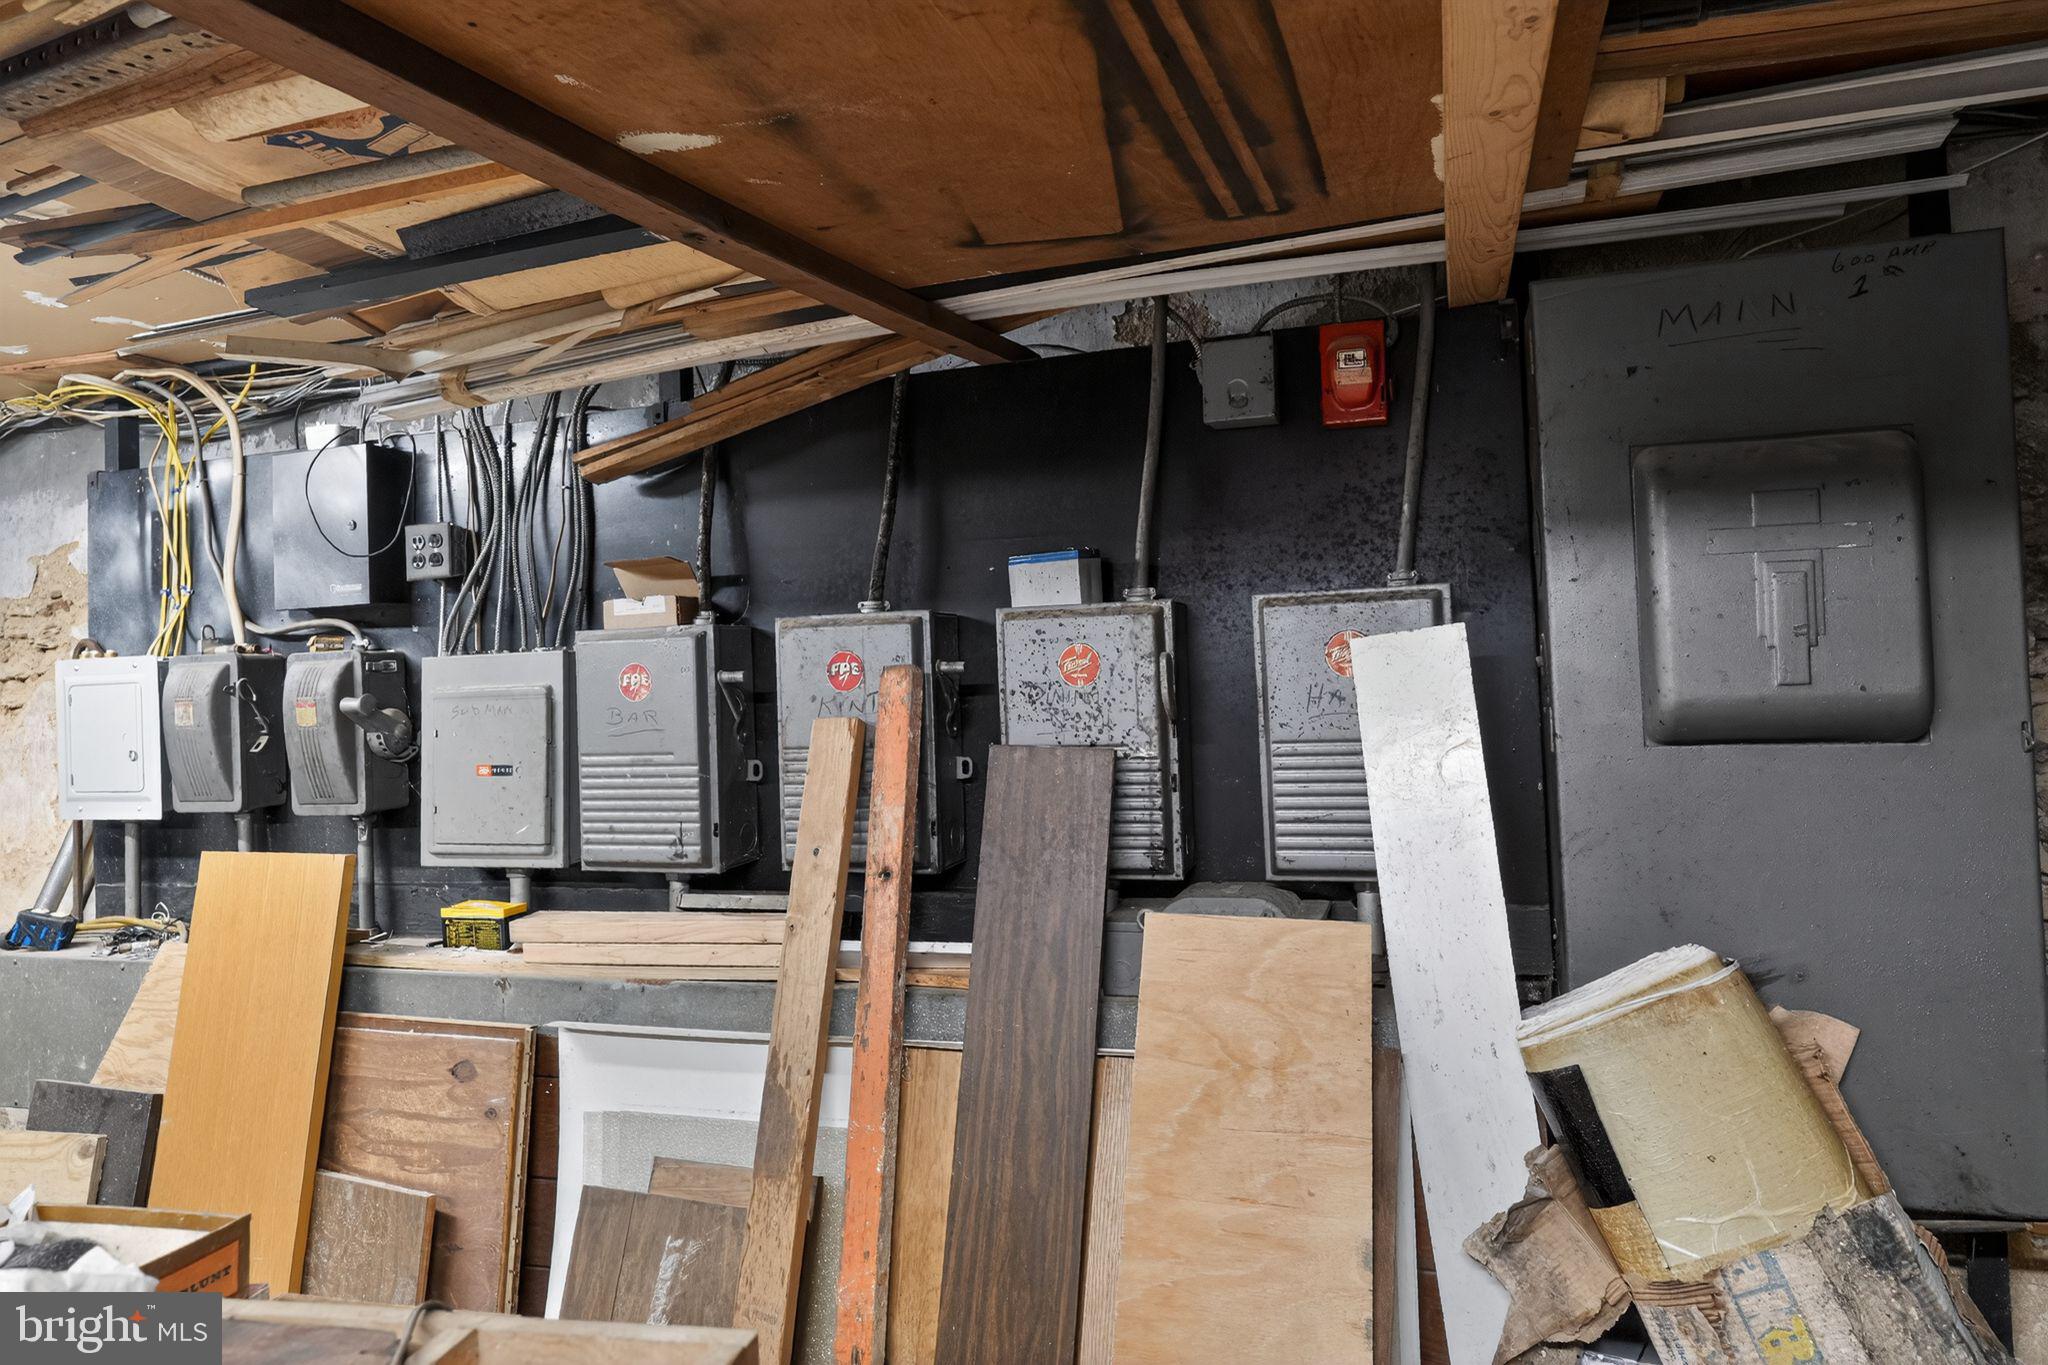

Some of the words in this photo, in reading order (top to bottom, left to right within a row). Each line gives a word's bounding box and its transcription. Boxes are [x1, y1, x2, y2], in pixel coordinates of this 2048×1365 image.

[1831, 252, 1875, 274] 600
[1887, 239, 1937, 260] AMP
[1657, 291, 1797, 338] MAIN
[605, 707, 659, 726] BAR
